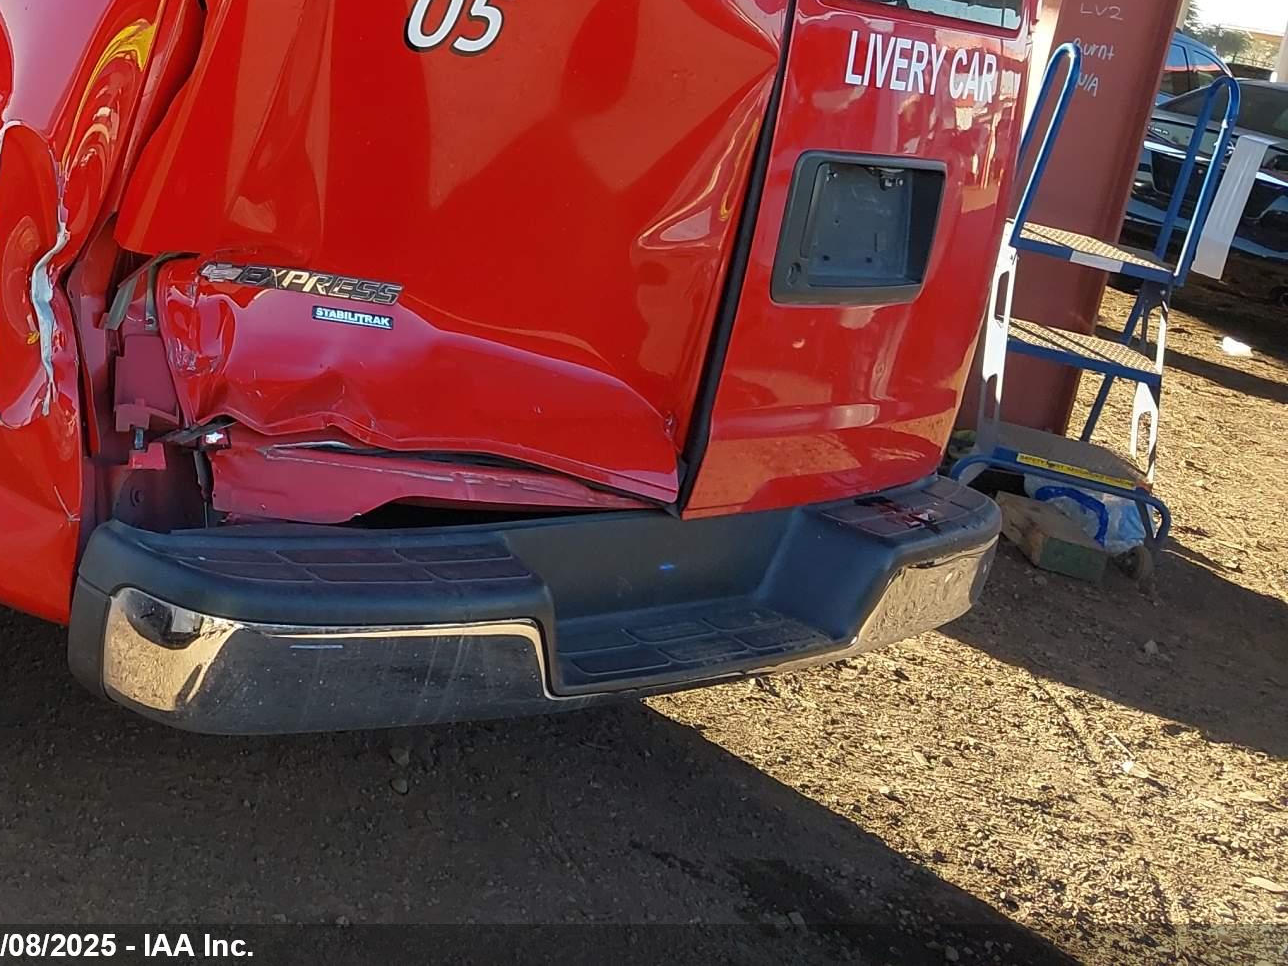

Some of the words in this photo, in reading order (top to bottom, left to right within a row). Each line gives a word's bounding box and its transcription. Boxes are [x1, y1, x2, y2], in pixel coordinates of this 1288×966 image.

[844, 30, 949, 96] LIVERY
[948, 48, 998, 104] CAR
[237, 266, 403, 306] EXPRESS
[315, 307, 391, 327] STABILITRAK
